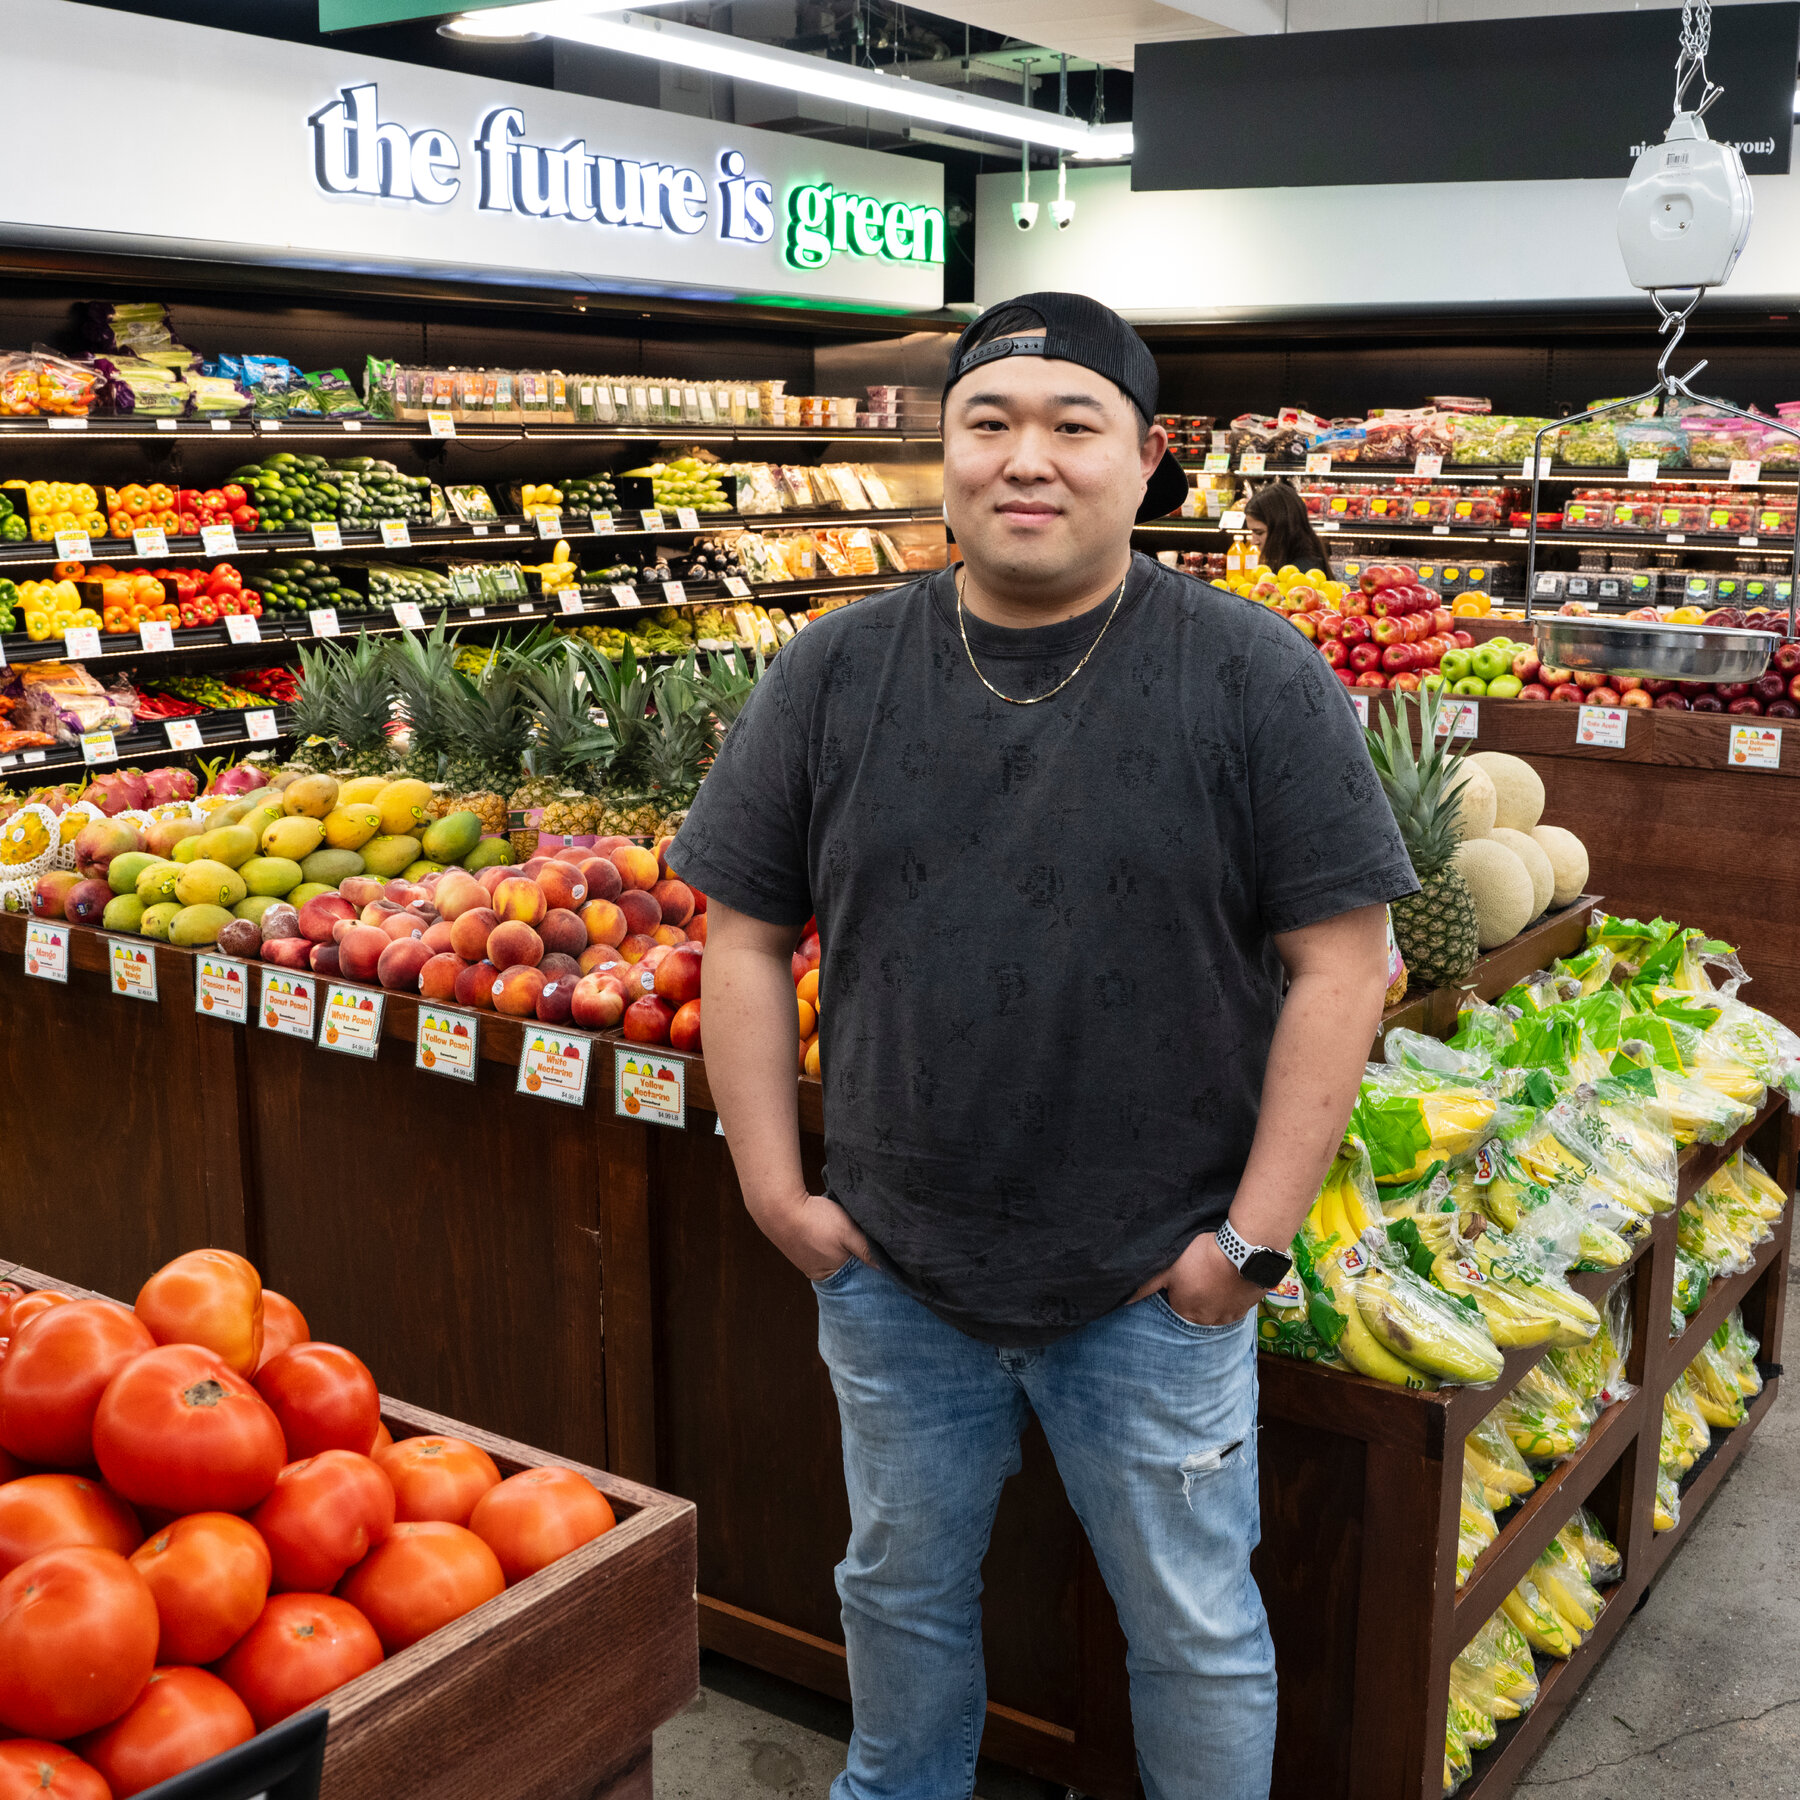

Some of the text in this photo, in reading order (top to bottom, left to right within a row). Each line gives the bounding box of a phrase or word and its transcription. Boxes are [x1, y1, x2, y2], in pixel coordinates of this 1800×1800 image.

[308, 83, 945, 269] the future is green
[36, 946, 56, 961] Mango
[203, 979, 242, 994] Passion Fruit
[269, 995, 308, 1012] Donut Peach
[331, 1010, 373, 1027] White Peach
[425, 1033, 470, 1051] Yellow Peach
[546, 1054, 567, 1067] White
[453, 1067, 465, 1075] $4.99
[537, 1062, 573, 1078] Nectarine
[640, 1078, 664, 1091] Yellow
[561, 1091, 574, 1100] $4.99
[634, 1087, 670, 1102] Nectarine
[658, 1111, 671, 1119] $4.99
[1478, 1150, 1490, 1179] Dole
[1270, 1281, 1299, 1296] ole
